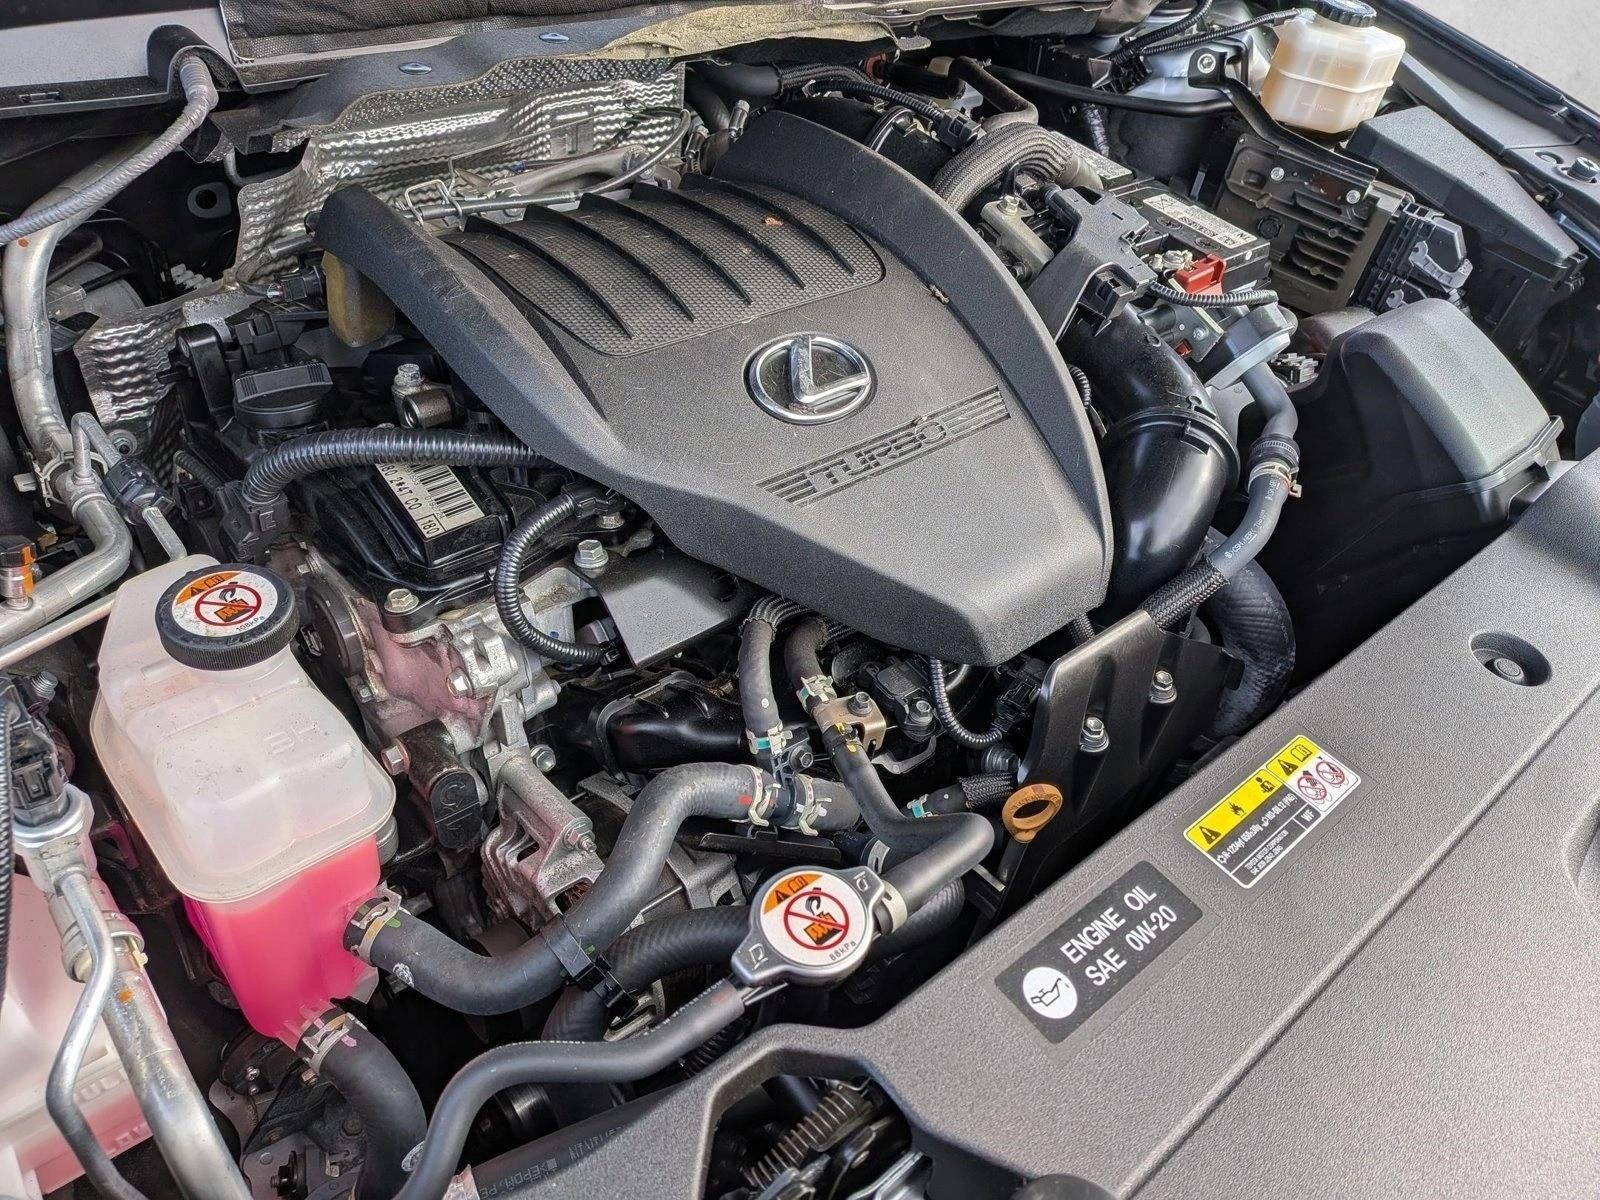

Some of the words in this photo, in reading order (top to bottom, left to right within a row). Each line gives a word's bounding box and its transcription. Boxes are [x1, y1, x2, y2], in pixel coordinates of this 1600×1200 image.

[806, 420, 949, 486] TURBO
[420, 519, 440, 535] 180
[1301, 809, 1316, 822] WF
[1244, 857, 1259, 870] TOYOTA
[1266, 829, 1289, 850] CORPORATION
[1060, 907, 1126, 964] ENGINE
[1123, 885, 1157, 911] OIL
[829, 940, 857, 961] 88kPa
[1085, 947, 1127, 986] SAE
[1125, 905, 1178, 951] 0W-20
